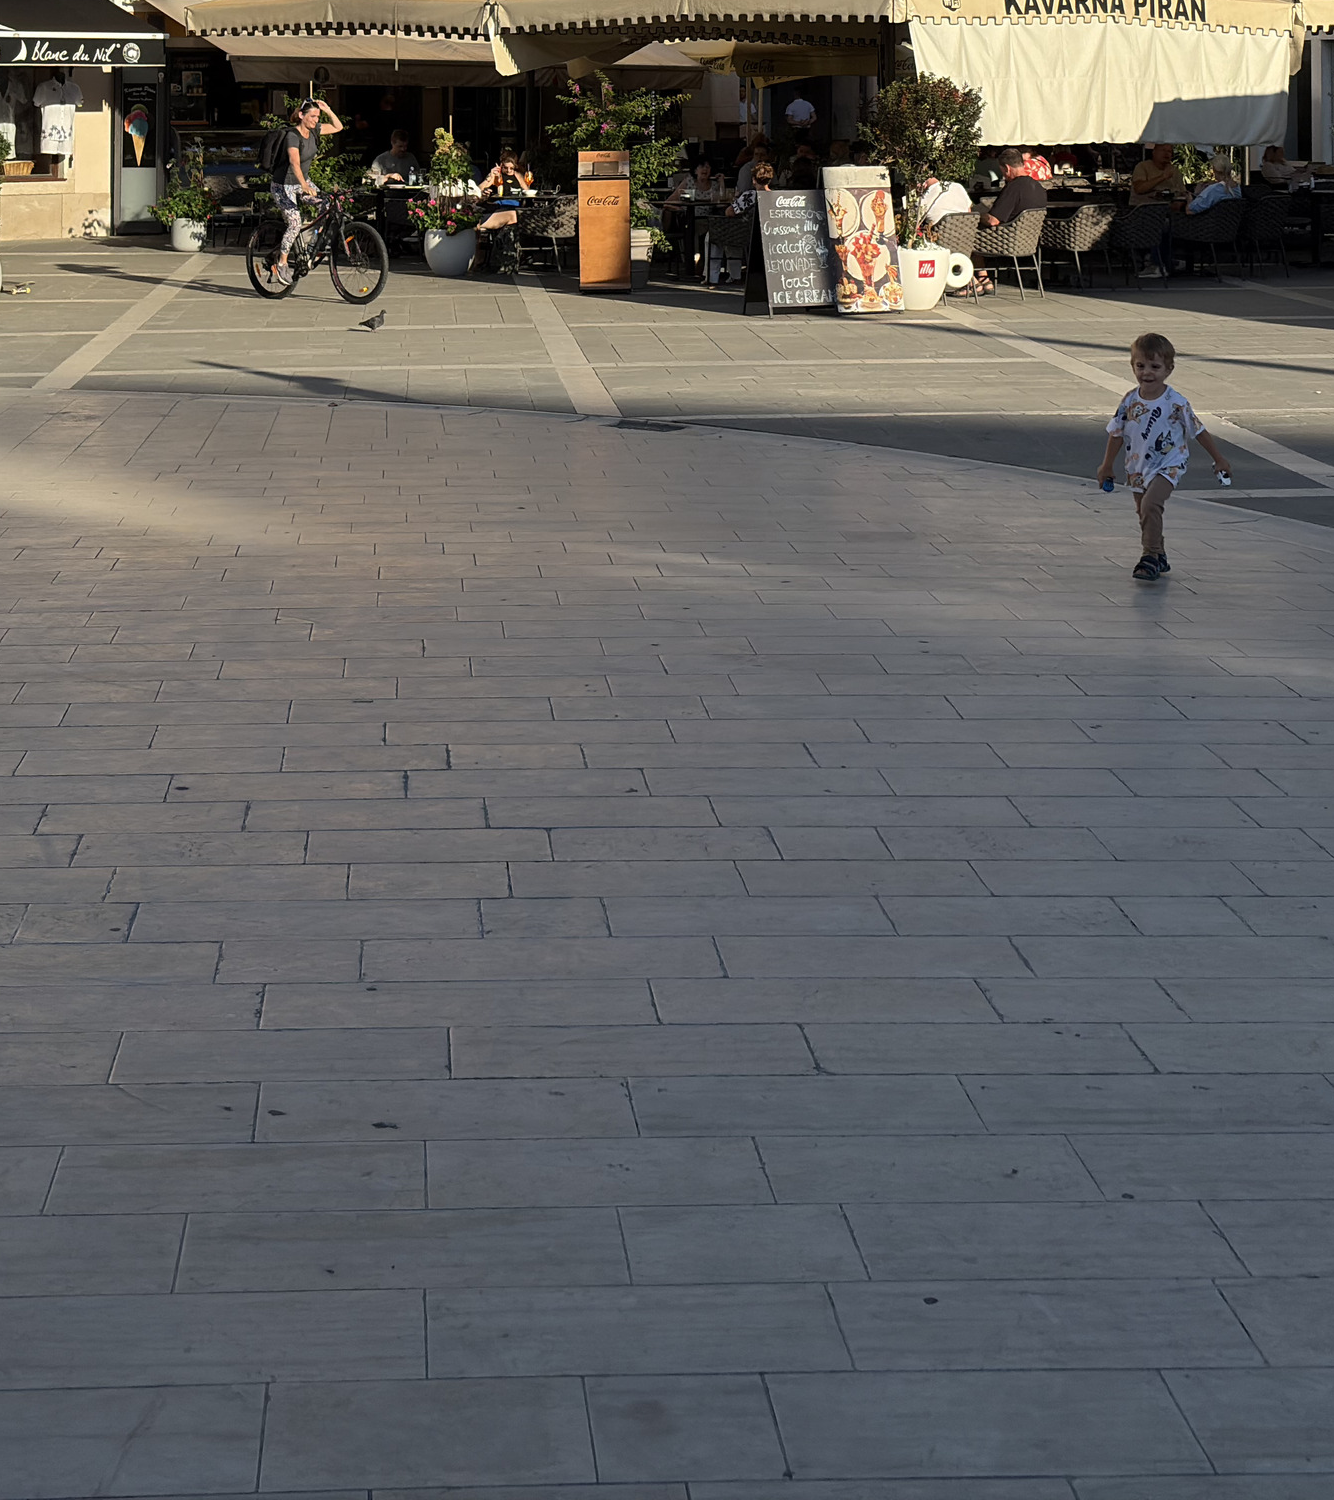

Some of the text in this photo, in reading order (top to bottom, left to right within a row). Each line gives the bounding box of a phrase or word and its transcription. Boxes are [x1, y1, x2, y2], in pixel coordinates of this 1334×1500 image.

[31, 40, 69, 62] Blanc
[72, 44, 90, 62] du
[92, 43, 117, 63] Nil
[769, 209, 814, 219] ESPRESSO
[919, 263, 935, 276] illy
[781, 272, 817, 290] toast
[773, 291, 793, 303] ICE
